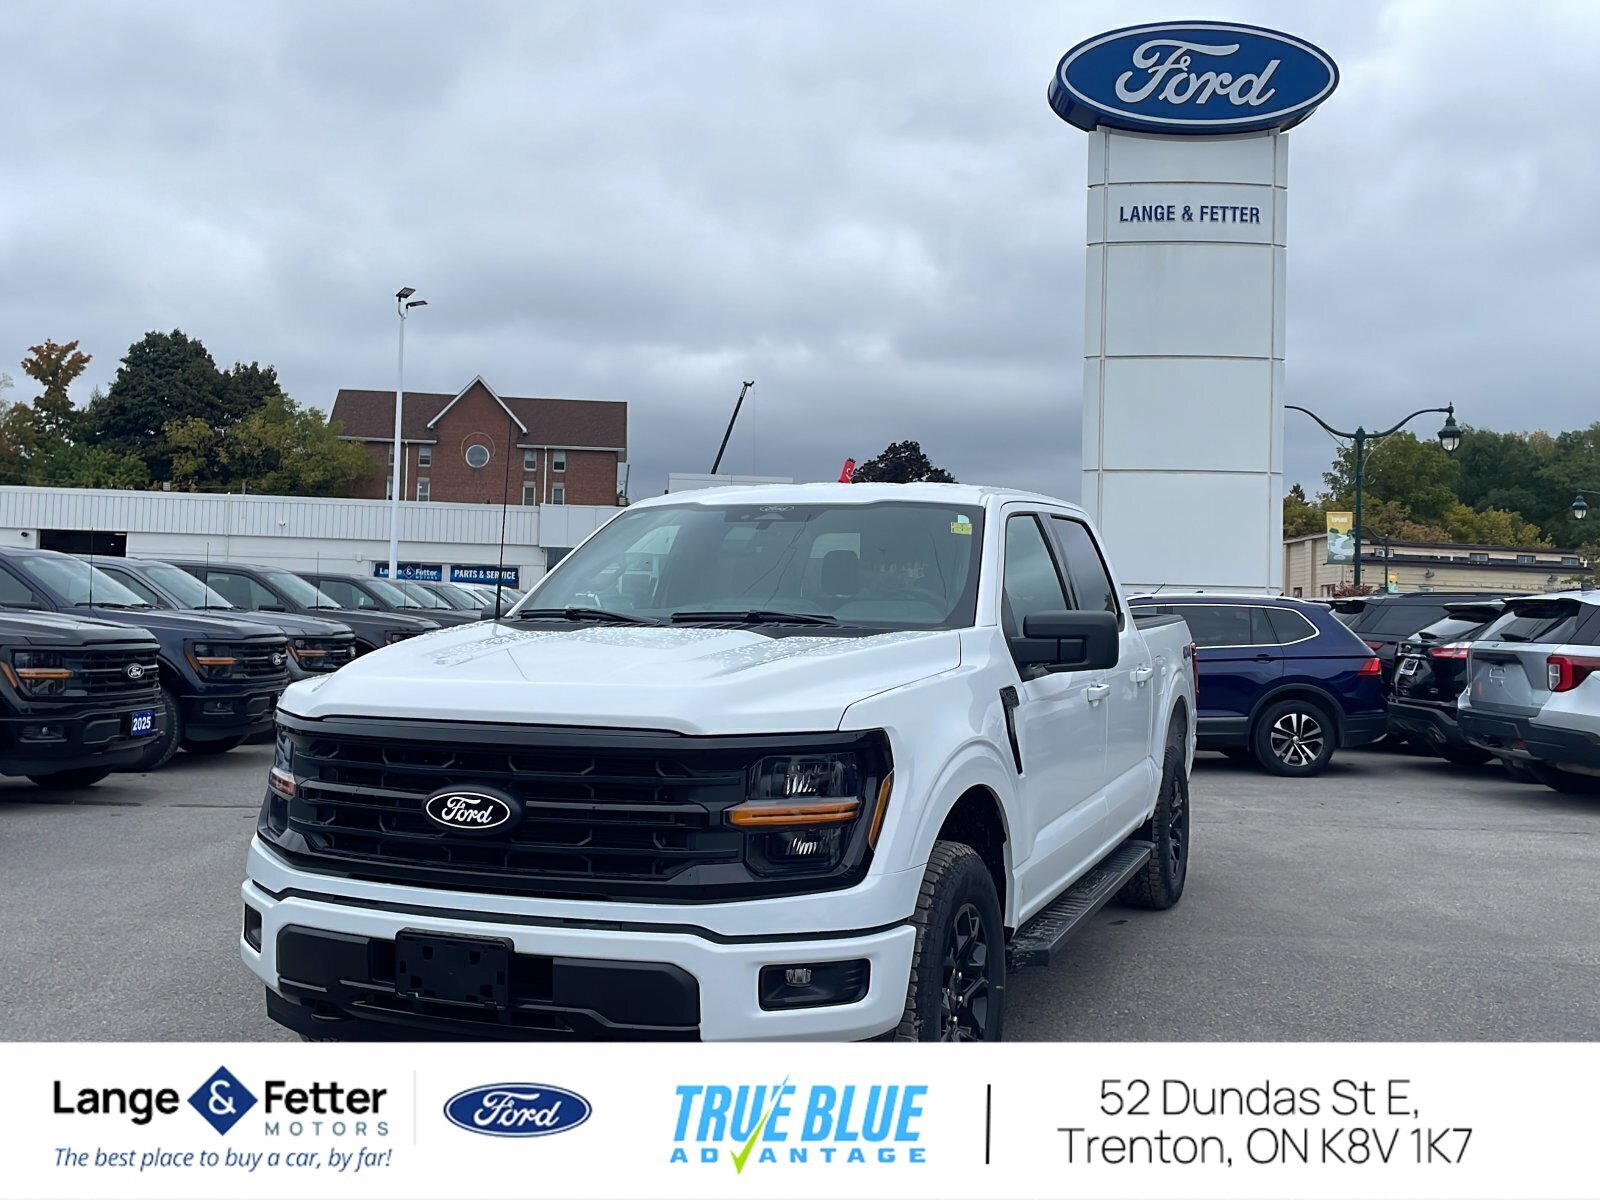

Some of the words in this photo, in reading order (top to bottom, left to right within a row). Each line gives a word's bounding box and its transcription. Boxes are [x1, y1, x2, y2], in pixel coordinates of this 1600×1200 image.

[1115, 39, 1280, 106] Ford
[1119, 204, 1176, 222] LANGE
[1181, 205, 1194, 222] &
[1199, 205, 1260, 223] FETTER
[379, 567, 403, 575] Lae
[415, 568, 437, 576] Fetter
[454, 569, 478, 579] PARTS
[479, 570, 484, 579] &
[132, 716, 152, 731] 2025
[441, 796, 494, 824] Ford
